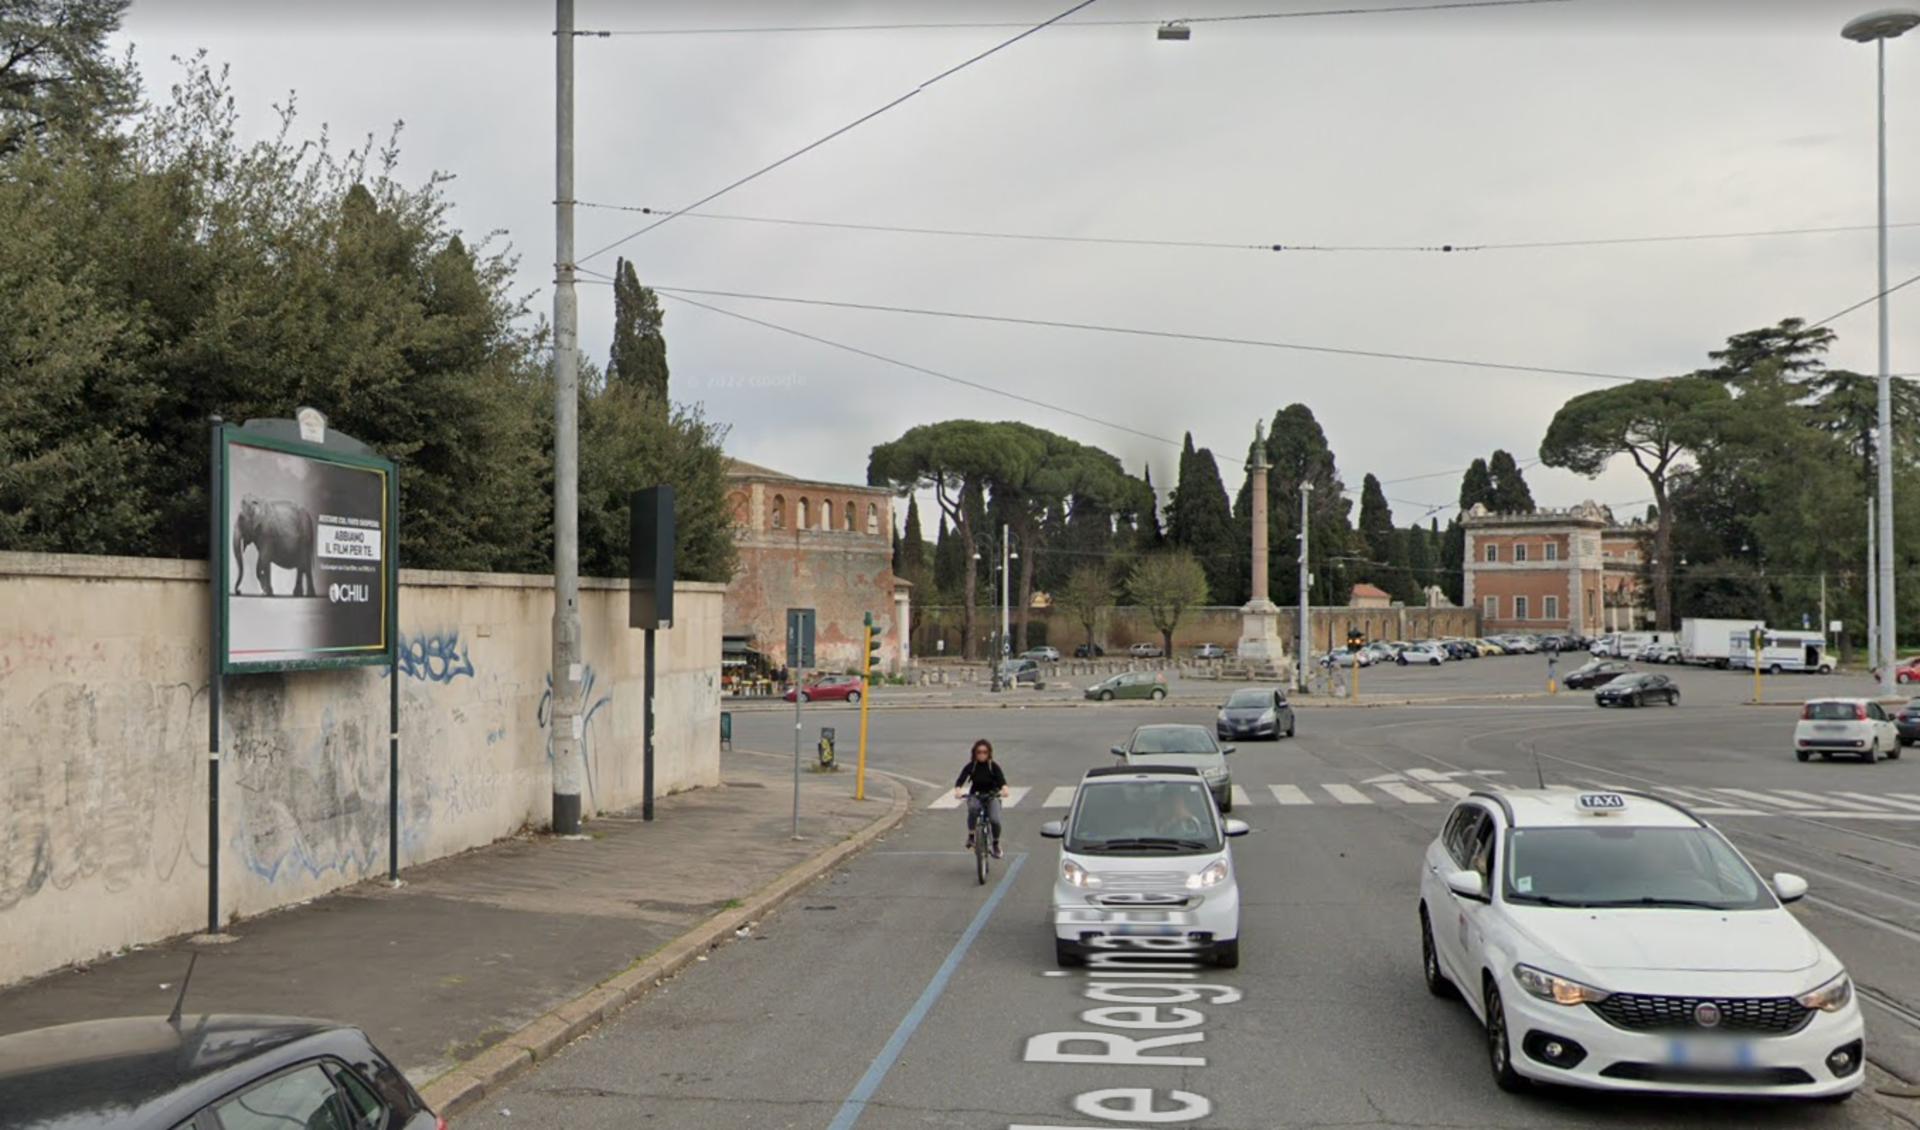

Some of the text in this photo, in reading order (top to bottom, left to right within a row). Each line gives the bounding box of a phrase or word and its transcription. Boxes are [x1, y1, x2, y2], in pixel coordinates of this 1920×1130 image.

[335, 530, 364, 543] ABBIAMO
[325, 542, 332, 554] IL
[333, 543, 349, 555] FILM
[350, 544, 363, 556] PER
[339, 584, 368, 602] CHILI
[1583, 796, 1621, 806] TAXI
